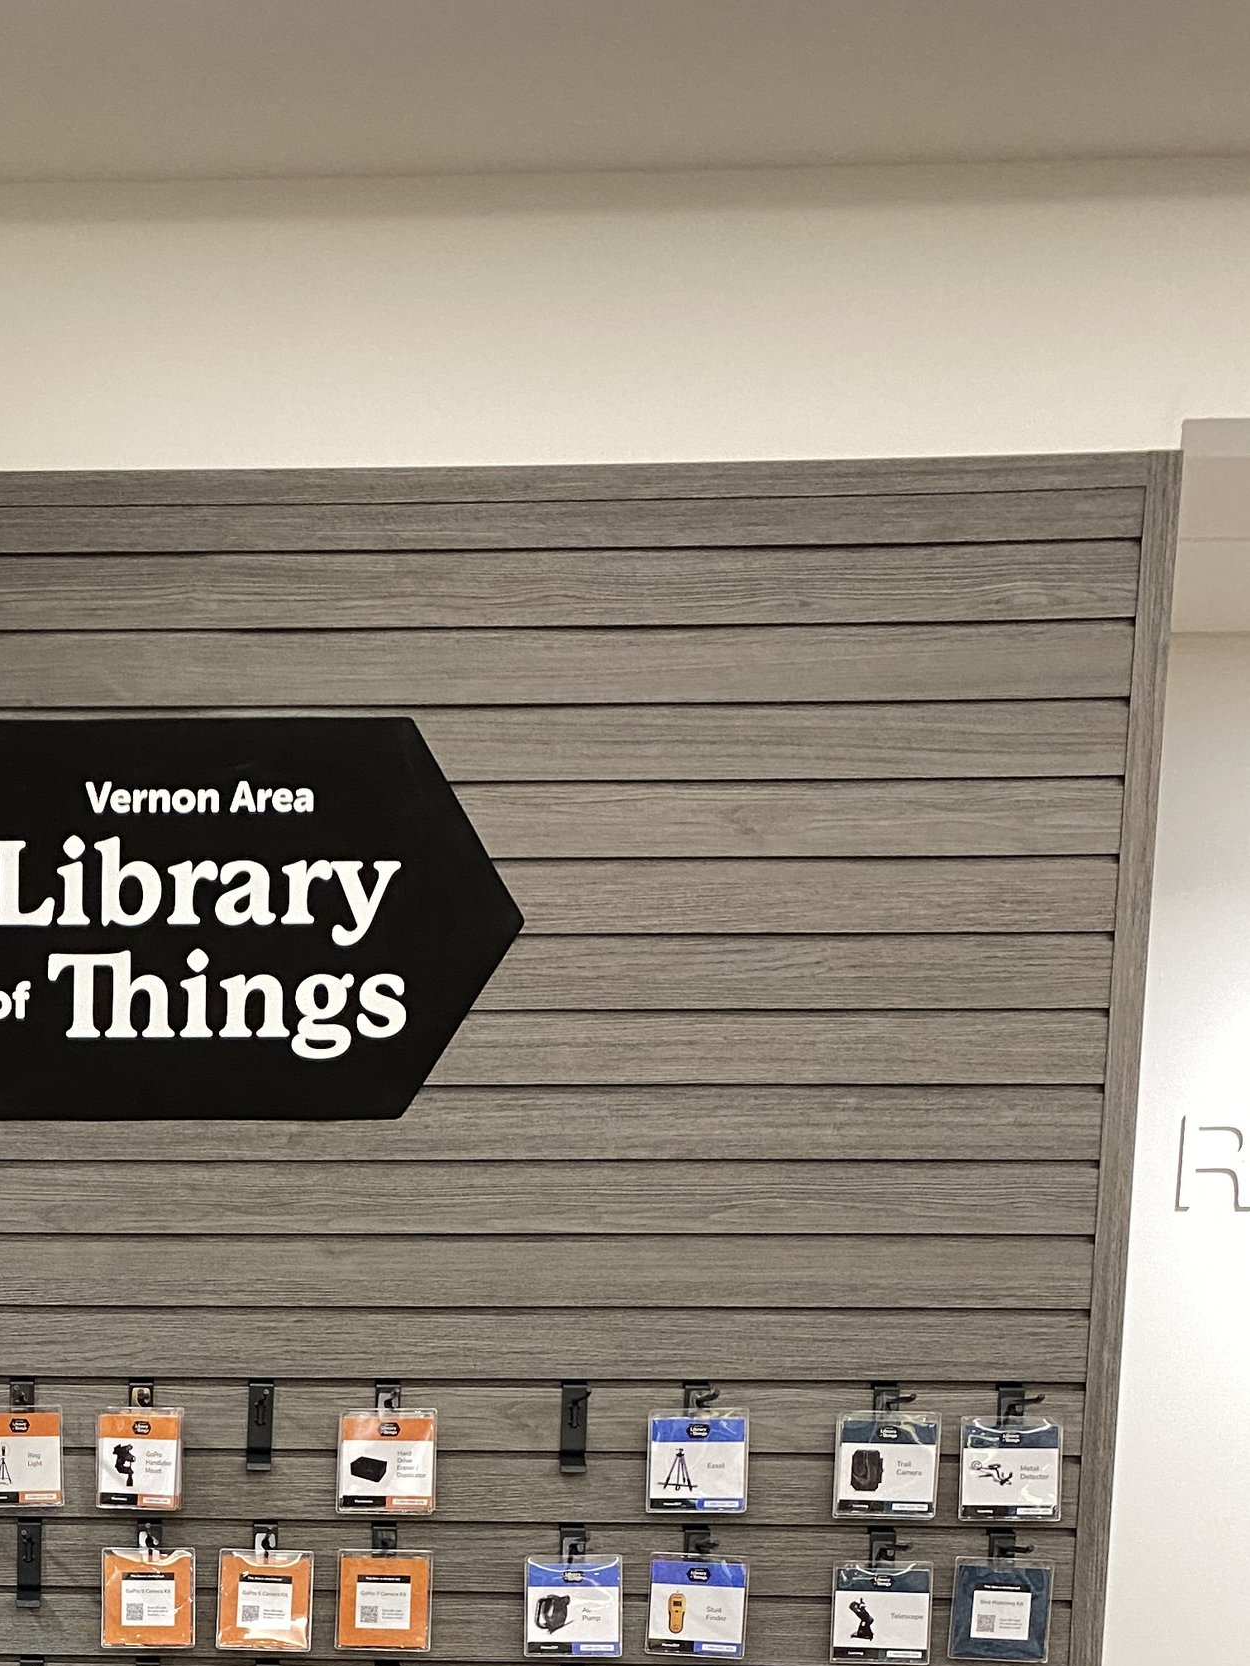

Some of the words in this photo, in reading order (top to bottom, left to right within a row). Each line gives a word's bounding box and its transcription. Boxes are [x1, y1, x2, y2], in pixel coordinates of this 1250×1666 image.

[86, 781, 220, 814] Vernon
[229, 780, 315, 814] Area
[47, 948, 408, 1061] Things
[582, 1614, 601, 1622] Pump
